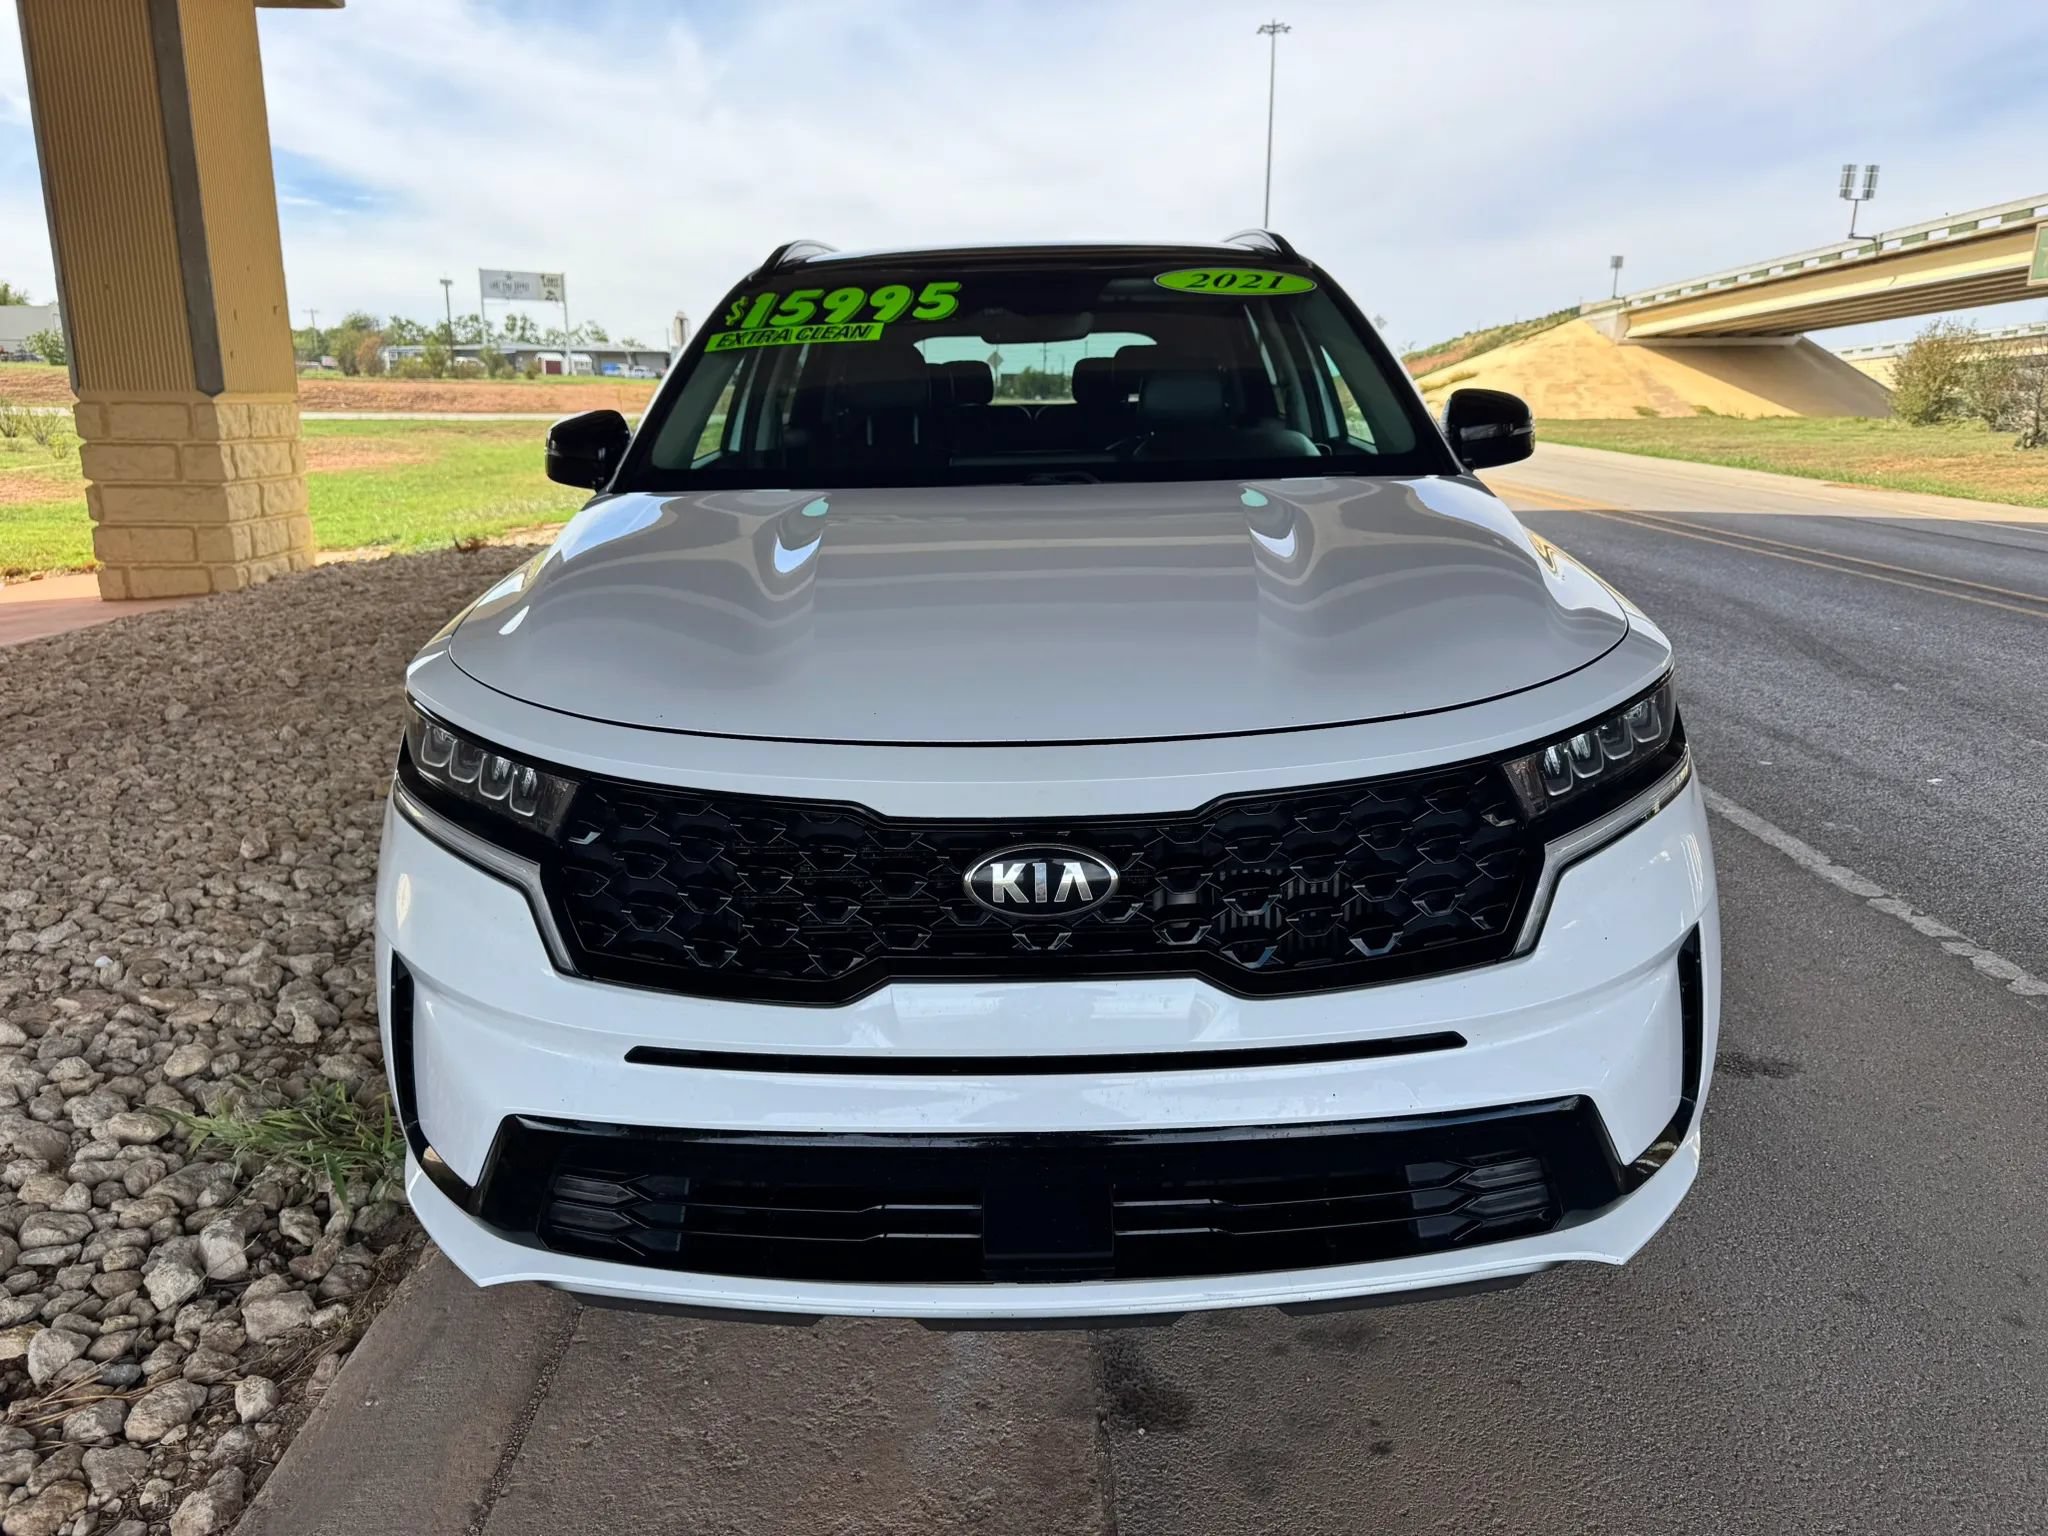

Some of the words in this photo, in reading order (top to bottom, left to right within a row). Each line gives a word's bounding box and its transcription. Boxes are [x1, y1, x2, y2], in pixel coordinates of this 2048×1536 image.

[1185, 273, 1285, 290] 2021
[725, 281, 962, 328] $15995
[716, 327, 794, 347] EXTRA
[798, 324, 872, 341] CLEAN
[991, 862, 1093, 903] KIA
